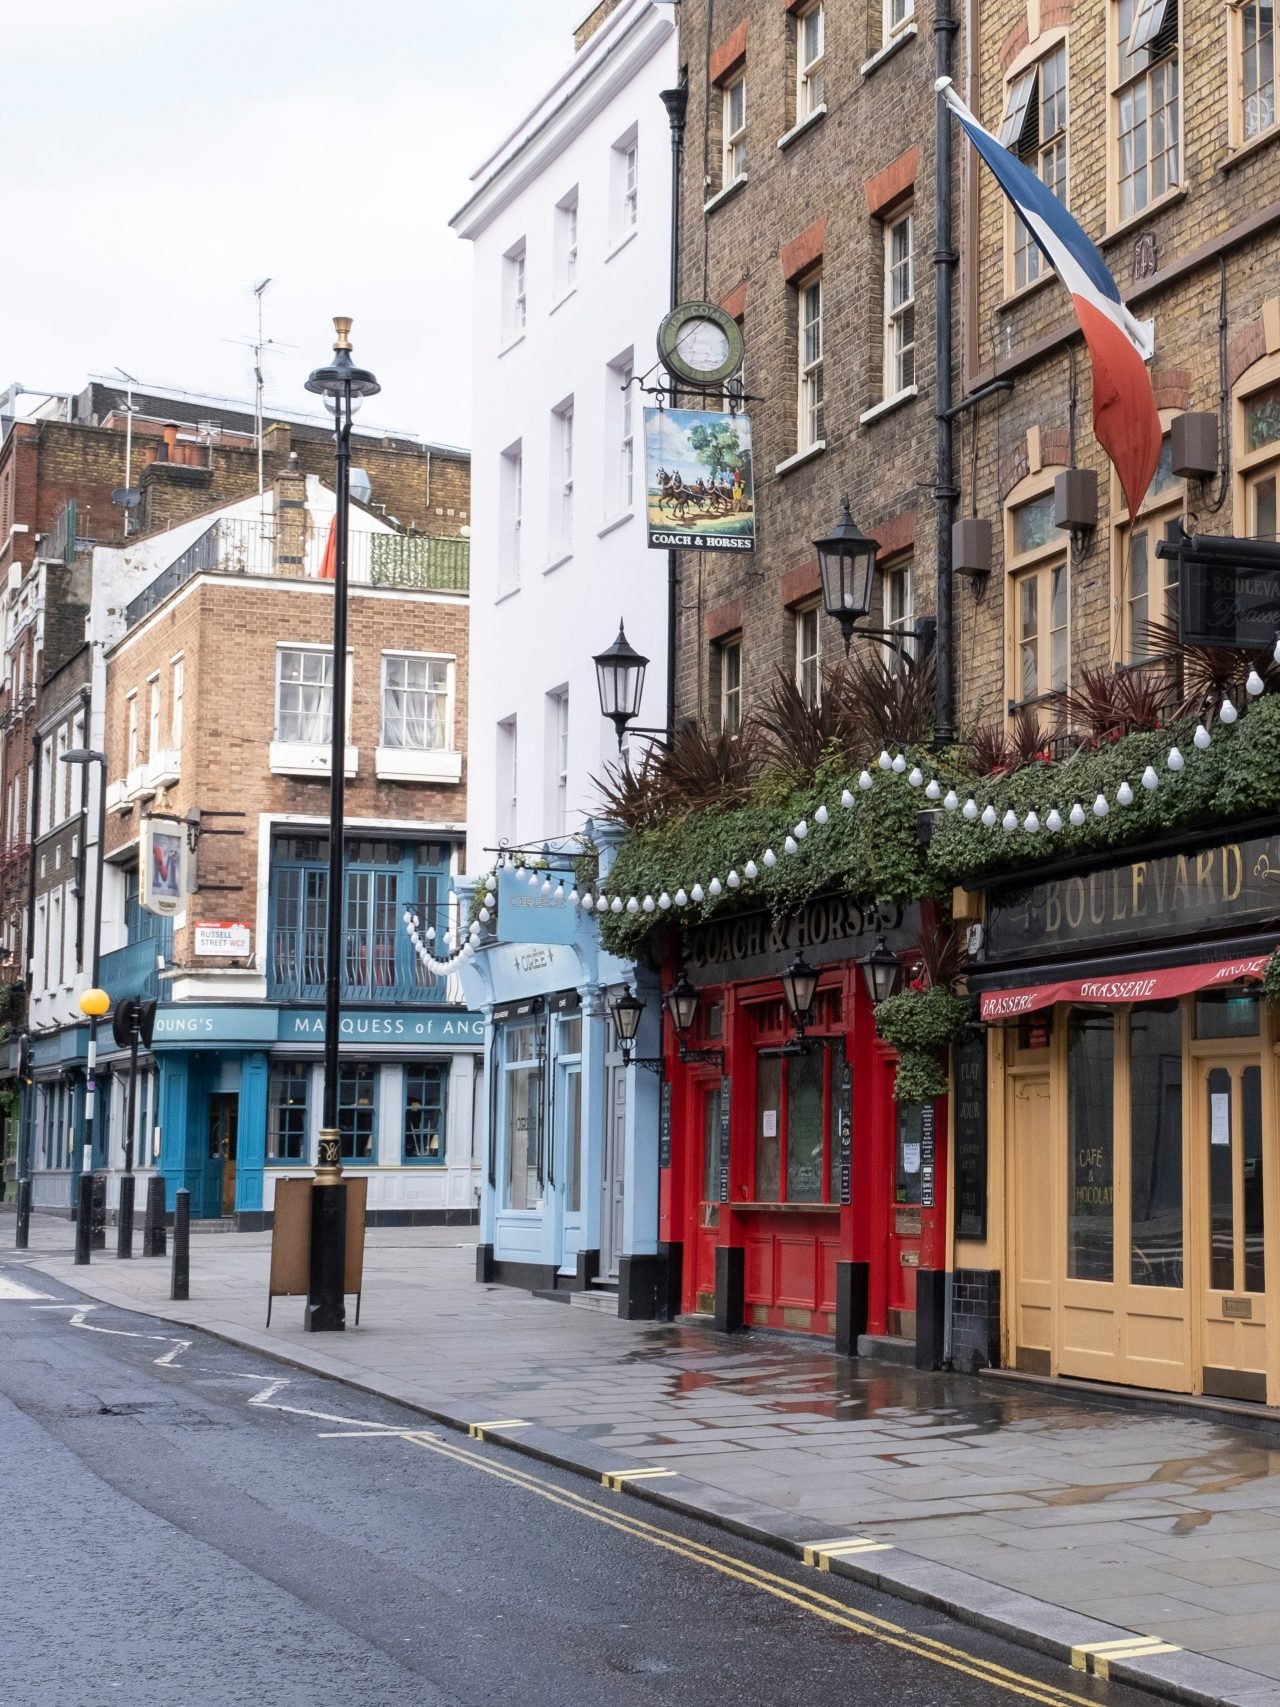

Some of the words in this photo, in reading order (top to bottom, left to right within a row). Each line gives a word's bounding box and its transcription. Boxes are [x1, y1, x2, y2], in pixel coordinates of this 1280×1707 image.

[652, 534, 691, 545] COACH
[694, 537, 703, 546] &
[706, 537, 751, 548] HORSES
[1044, 843, 1243, 932] BOULEVARD
[201, 931, 232, 939] RUSSELL
[692, 916, 764, 967] COACH
[769, 920, 789, 953] &
[156, 1019, 213, 1031] OUNG'S
[295, 1018, 404, 1034] MAQUESS
[415, 1020, 433, 1033] of
[961, 1063, 979, 1080] PLAT
[1080, 1147, 1103, 1168] CAFÉ
[1075, 1186, 1113, 1204] HOCOLAT
